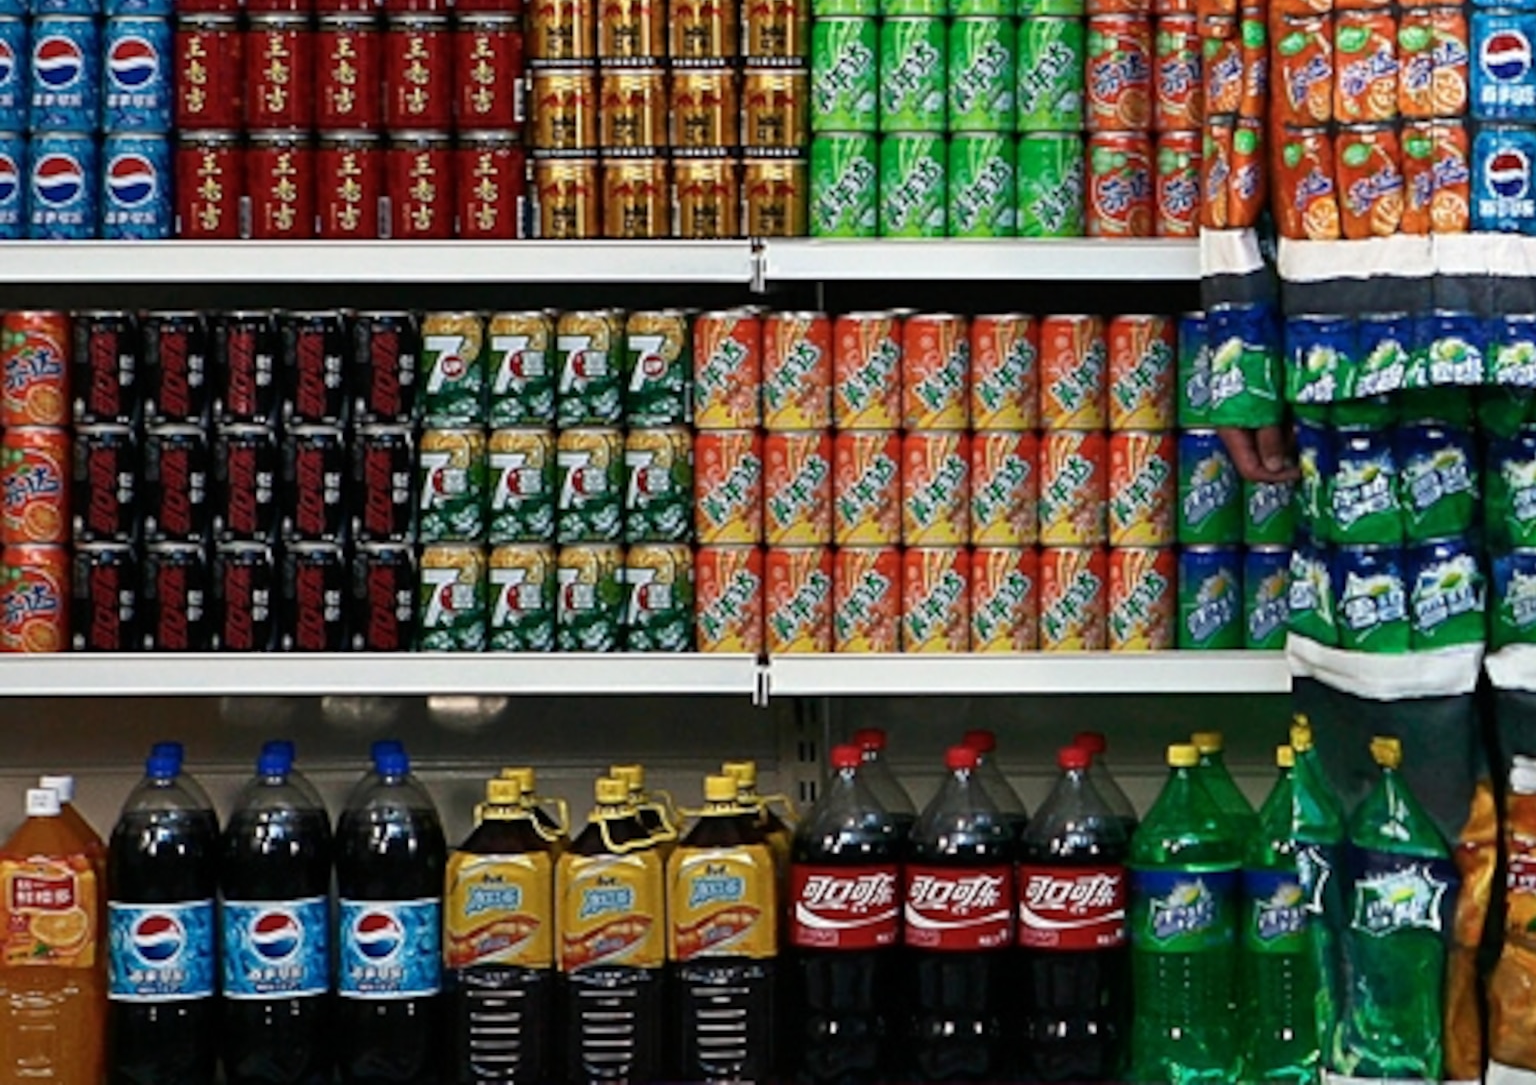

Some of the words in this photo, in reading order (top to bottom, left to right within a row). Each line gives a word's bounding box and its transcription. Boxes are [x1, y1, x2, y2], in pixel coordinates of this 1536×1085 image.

[184, 36, 207, 113] 王老吉
[264, 36, 289, 113] 王老吉
[331, 36, 356, 113] 王老吉
[403, 36, 429, 113] 王老吉
[470, 36, 495, 113] 王老吉
[197, 153, 222, 230] 王老吉
[271, 153, 297, 230] 王老吉
[336, 153, 362, 230] 王老吉
[409, 153, 435, 230] 王老吉
[473, 153, 499, 230] 王老吉
[802, 873, 897, 910] 可口可乐
[909, 873, 1003, 910] 可口可乐
[1025, 873, 1120, 910] 可口可乐
